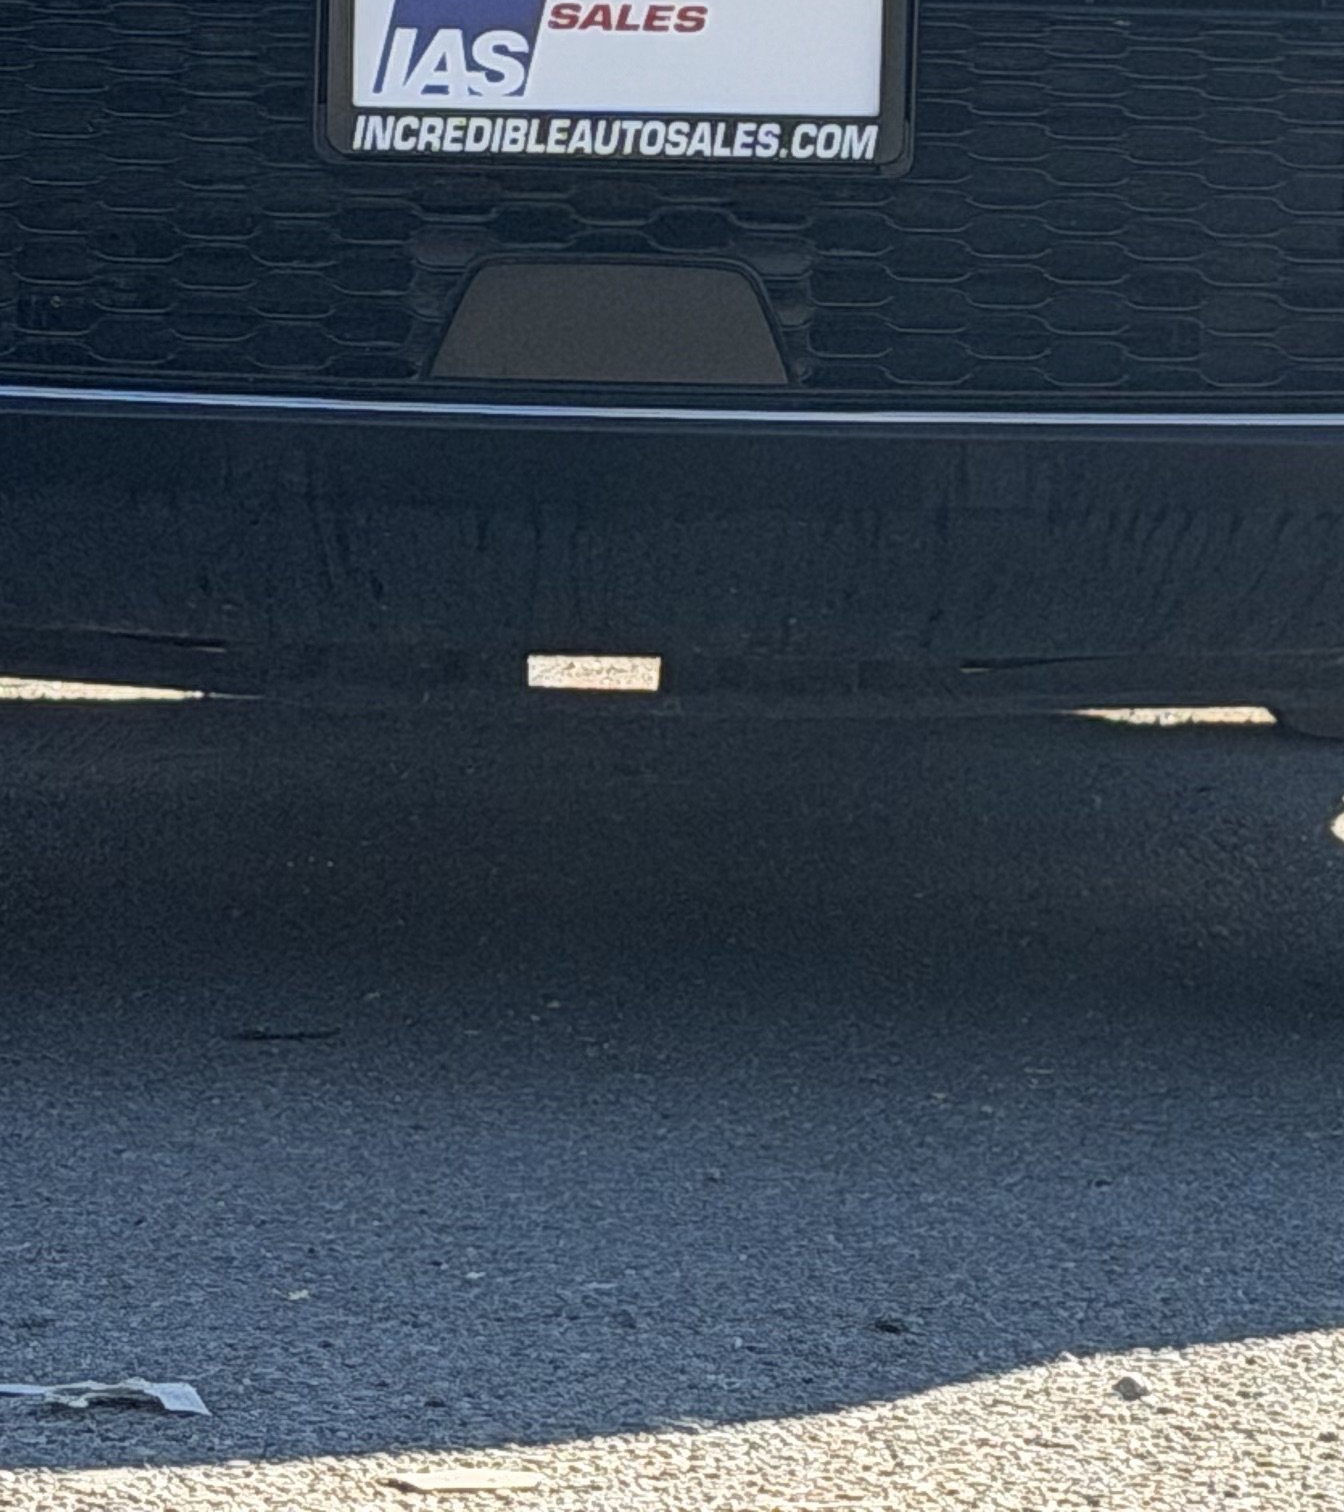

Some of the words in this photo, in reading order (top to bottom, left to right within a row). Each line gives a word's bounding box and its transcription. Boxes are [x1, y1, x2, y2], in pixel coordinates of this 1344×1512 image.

[548, 3, 708, 33] SALES
[388, 26, 530, 96] IAS
[353, 114, 879, 160] INCREDIBLEAUTOSALES.COM
